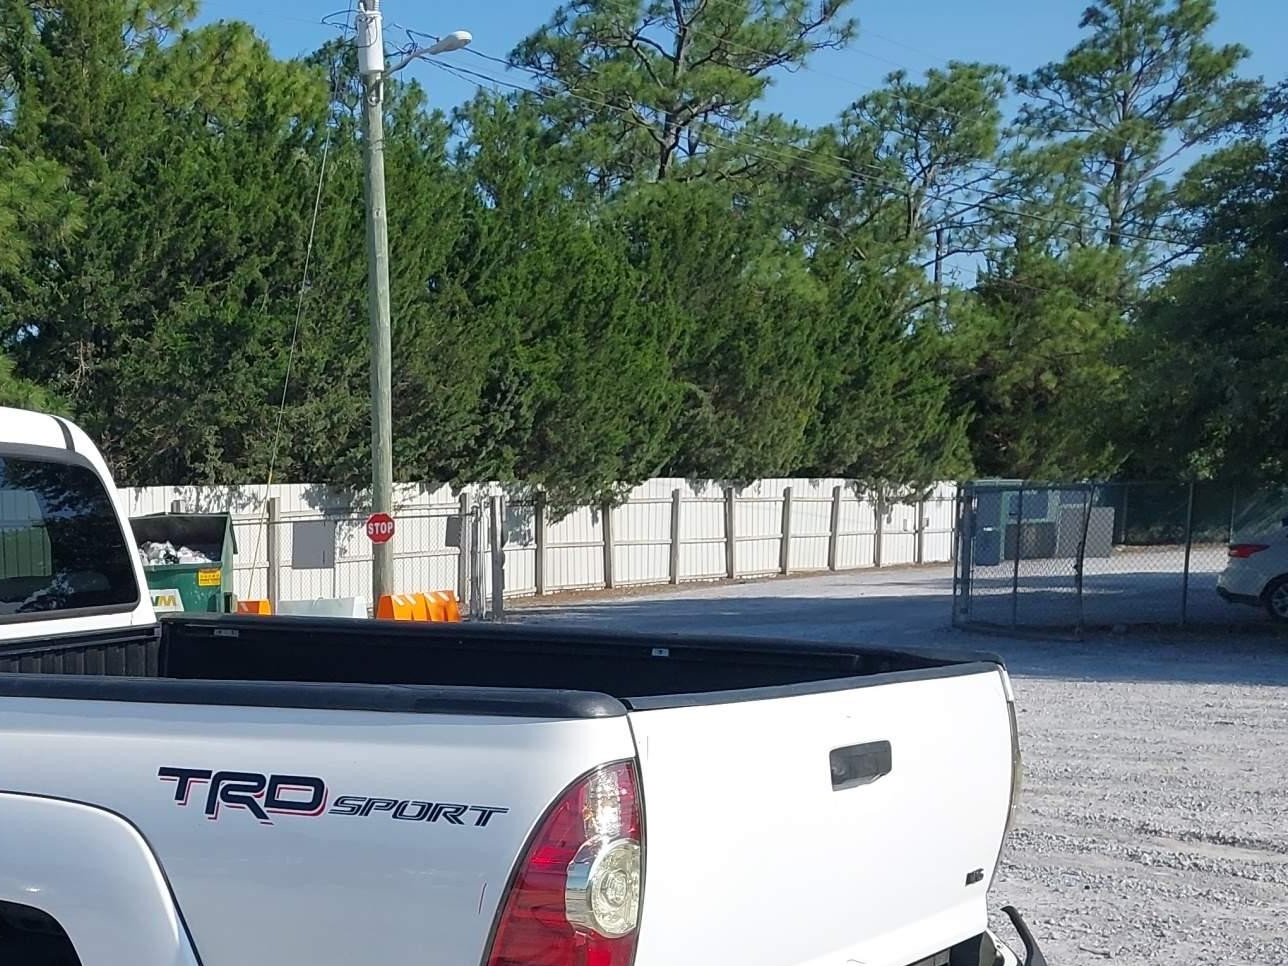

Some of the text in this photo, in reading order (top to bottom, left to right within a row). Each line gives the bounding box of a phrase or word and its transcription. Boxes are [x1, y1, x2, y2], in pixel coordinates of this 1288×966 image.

[367, 522, 393, 535] STOP
[158, 766, 510, 828] TRD SPORT
